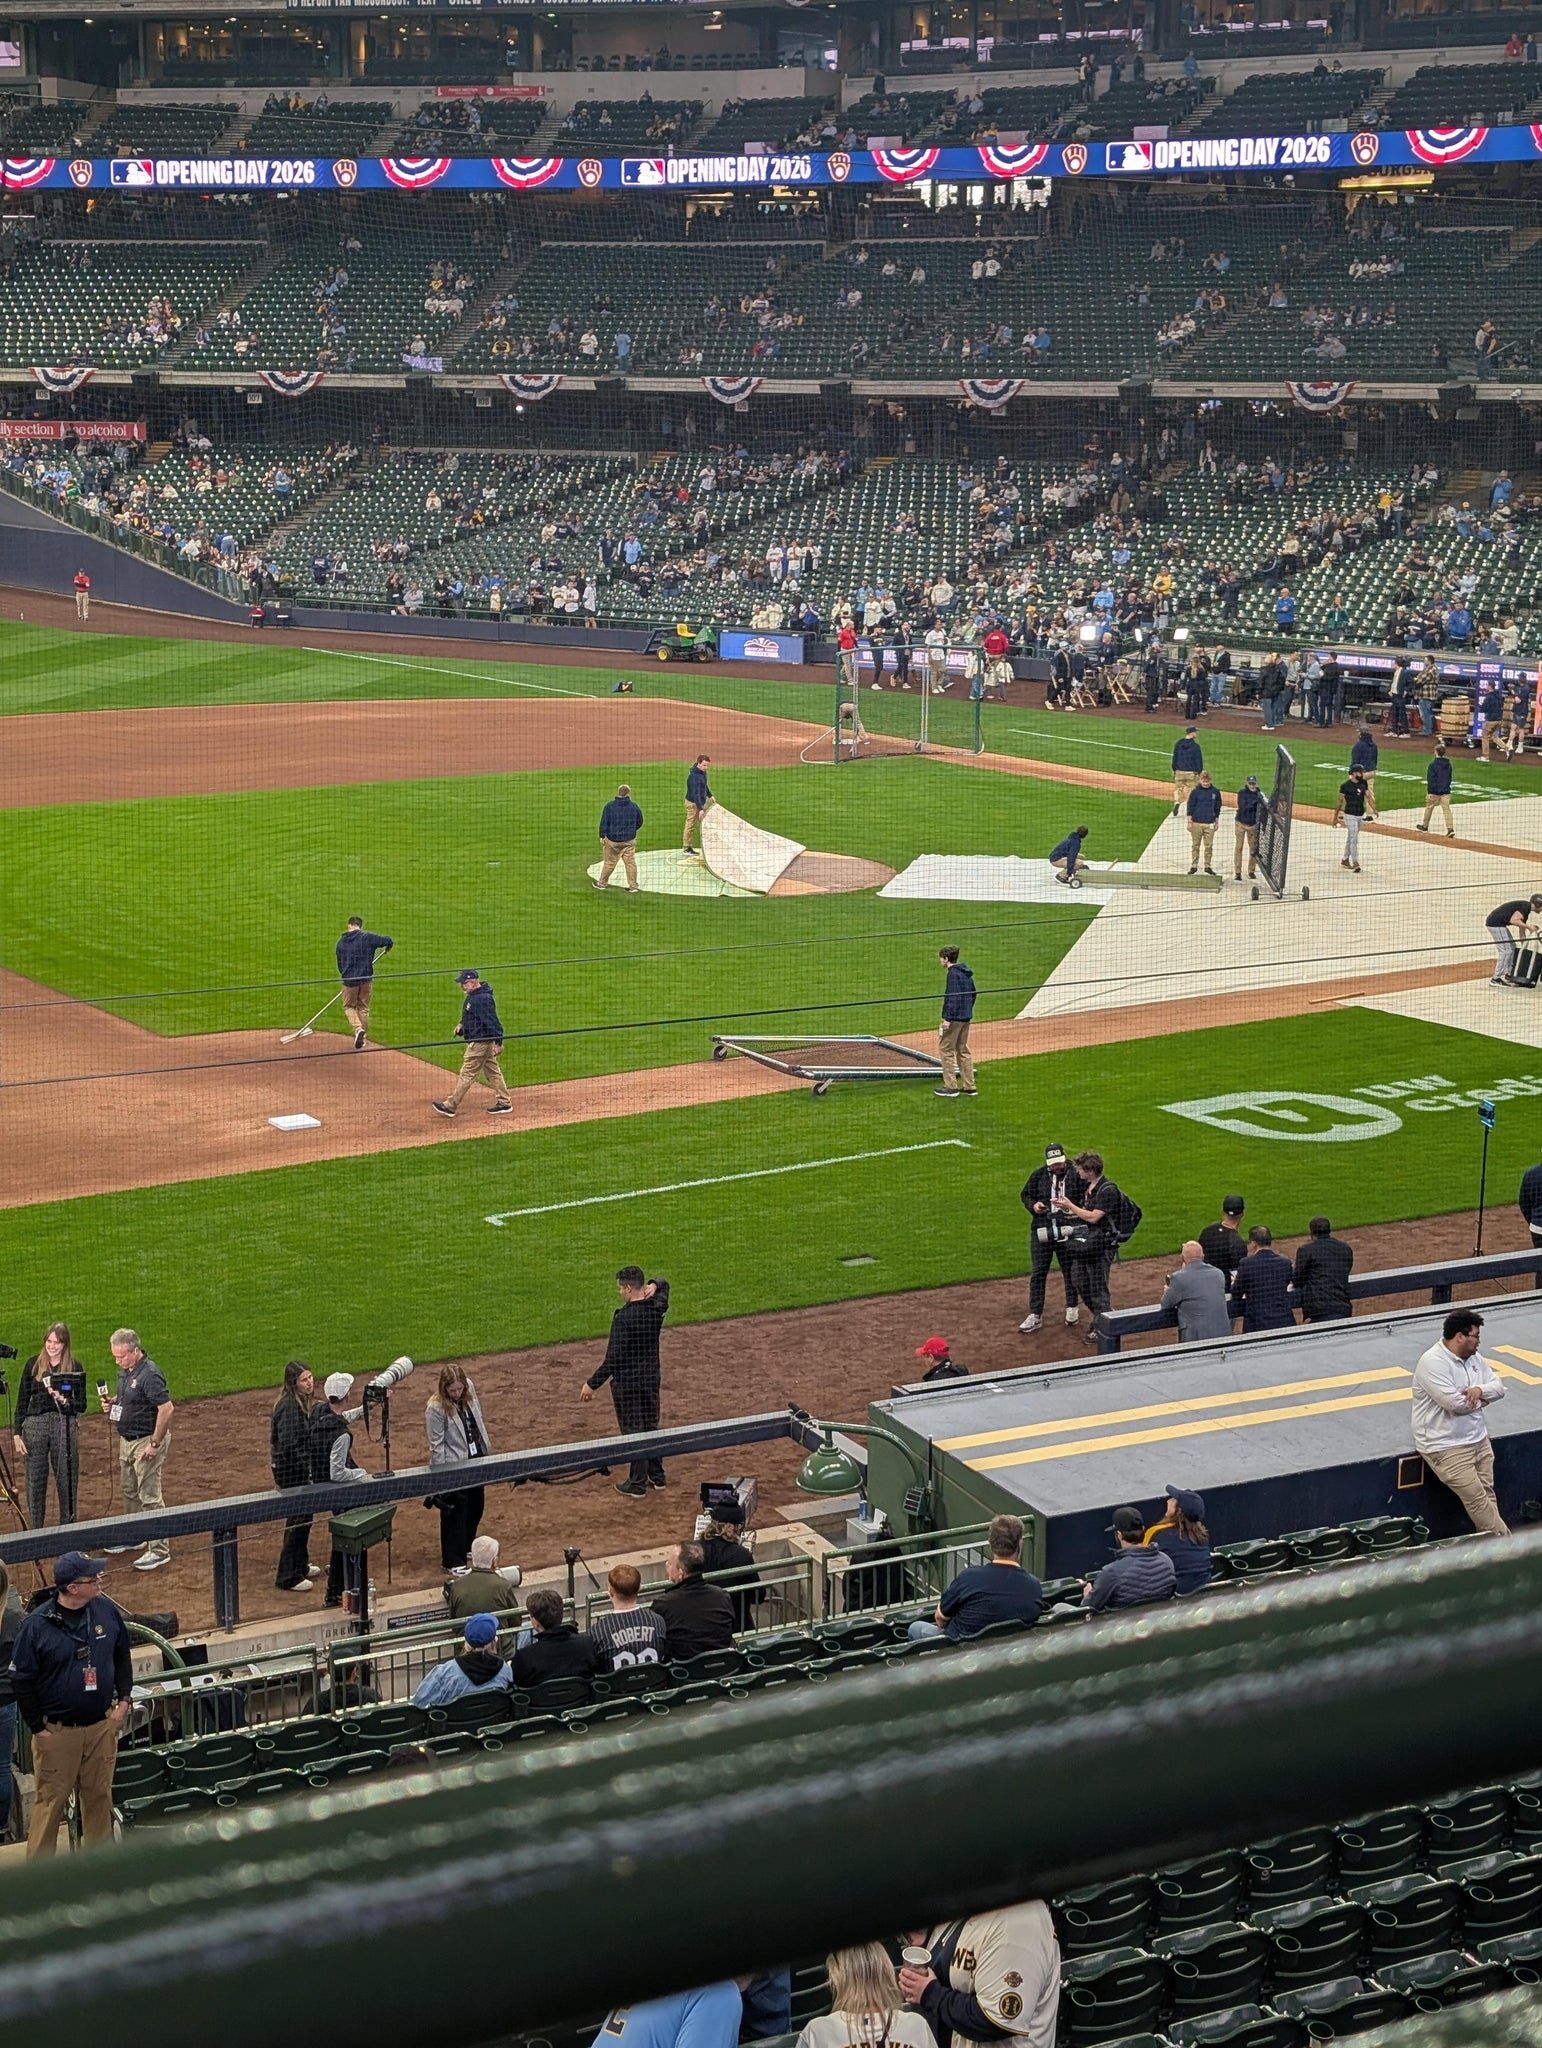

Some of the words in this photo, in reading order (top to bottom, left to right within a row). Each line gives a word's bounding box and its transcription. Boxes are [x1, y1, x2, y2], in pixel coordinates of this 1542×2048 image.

[1155, 139, 1239, 169] OPENING
[1239, 137, 1280, 166] DAY
[1280, 136, 1331, 164] 2026
[156, 160, 233, 184] OPENING
[234, 160, 269, 184] DAY
[271, 160, 315, 184] 2026
[667, 157, 737, 183] OPENING
[737, 156, 770, 182] DAY
[248, 392, 260, 402] 107
[14, 423, 54, 435] section
[87, 424, 127, 437] alcohol
[611, 1625, 655, 1649] ROBERT
[138, 1662, 152, 1673] AP
